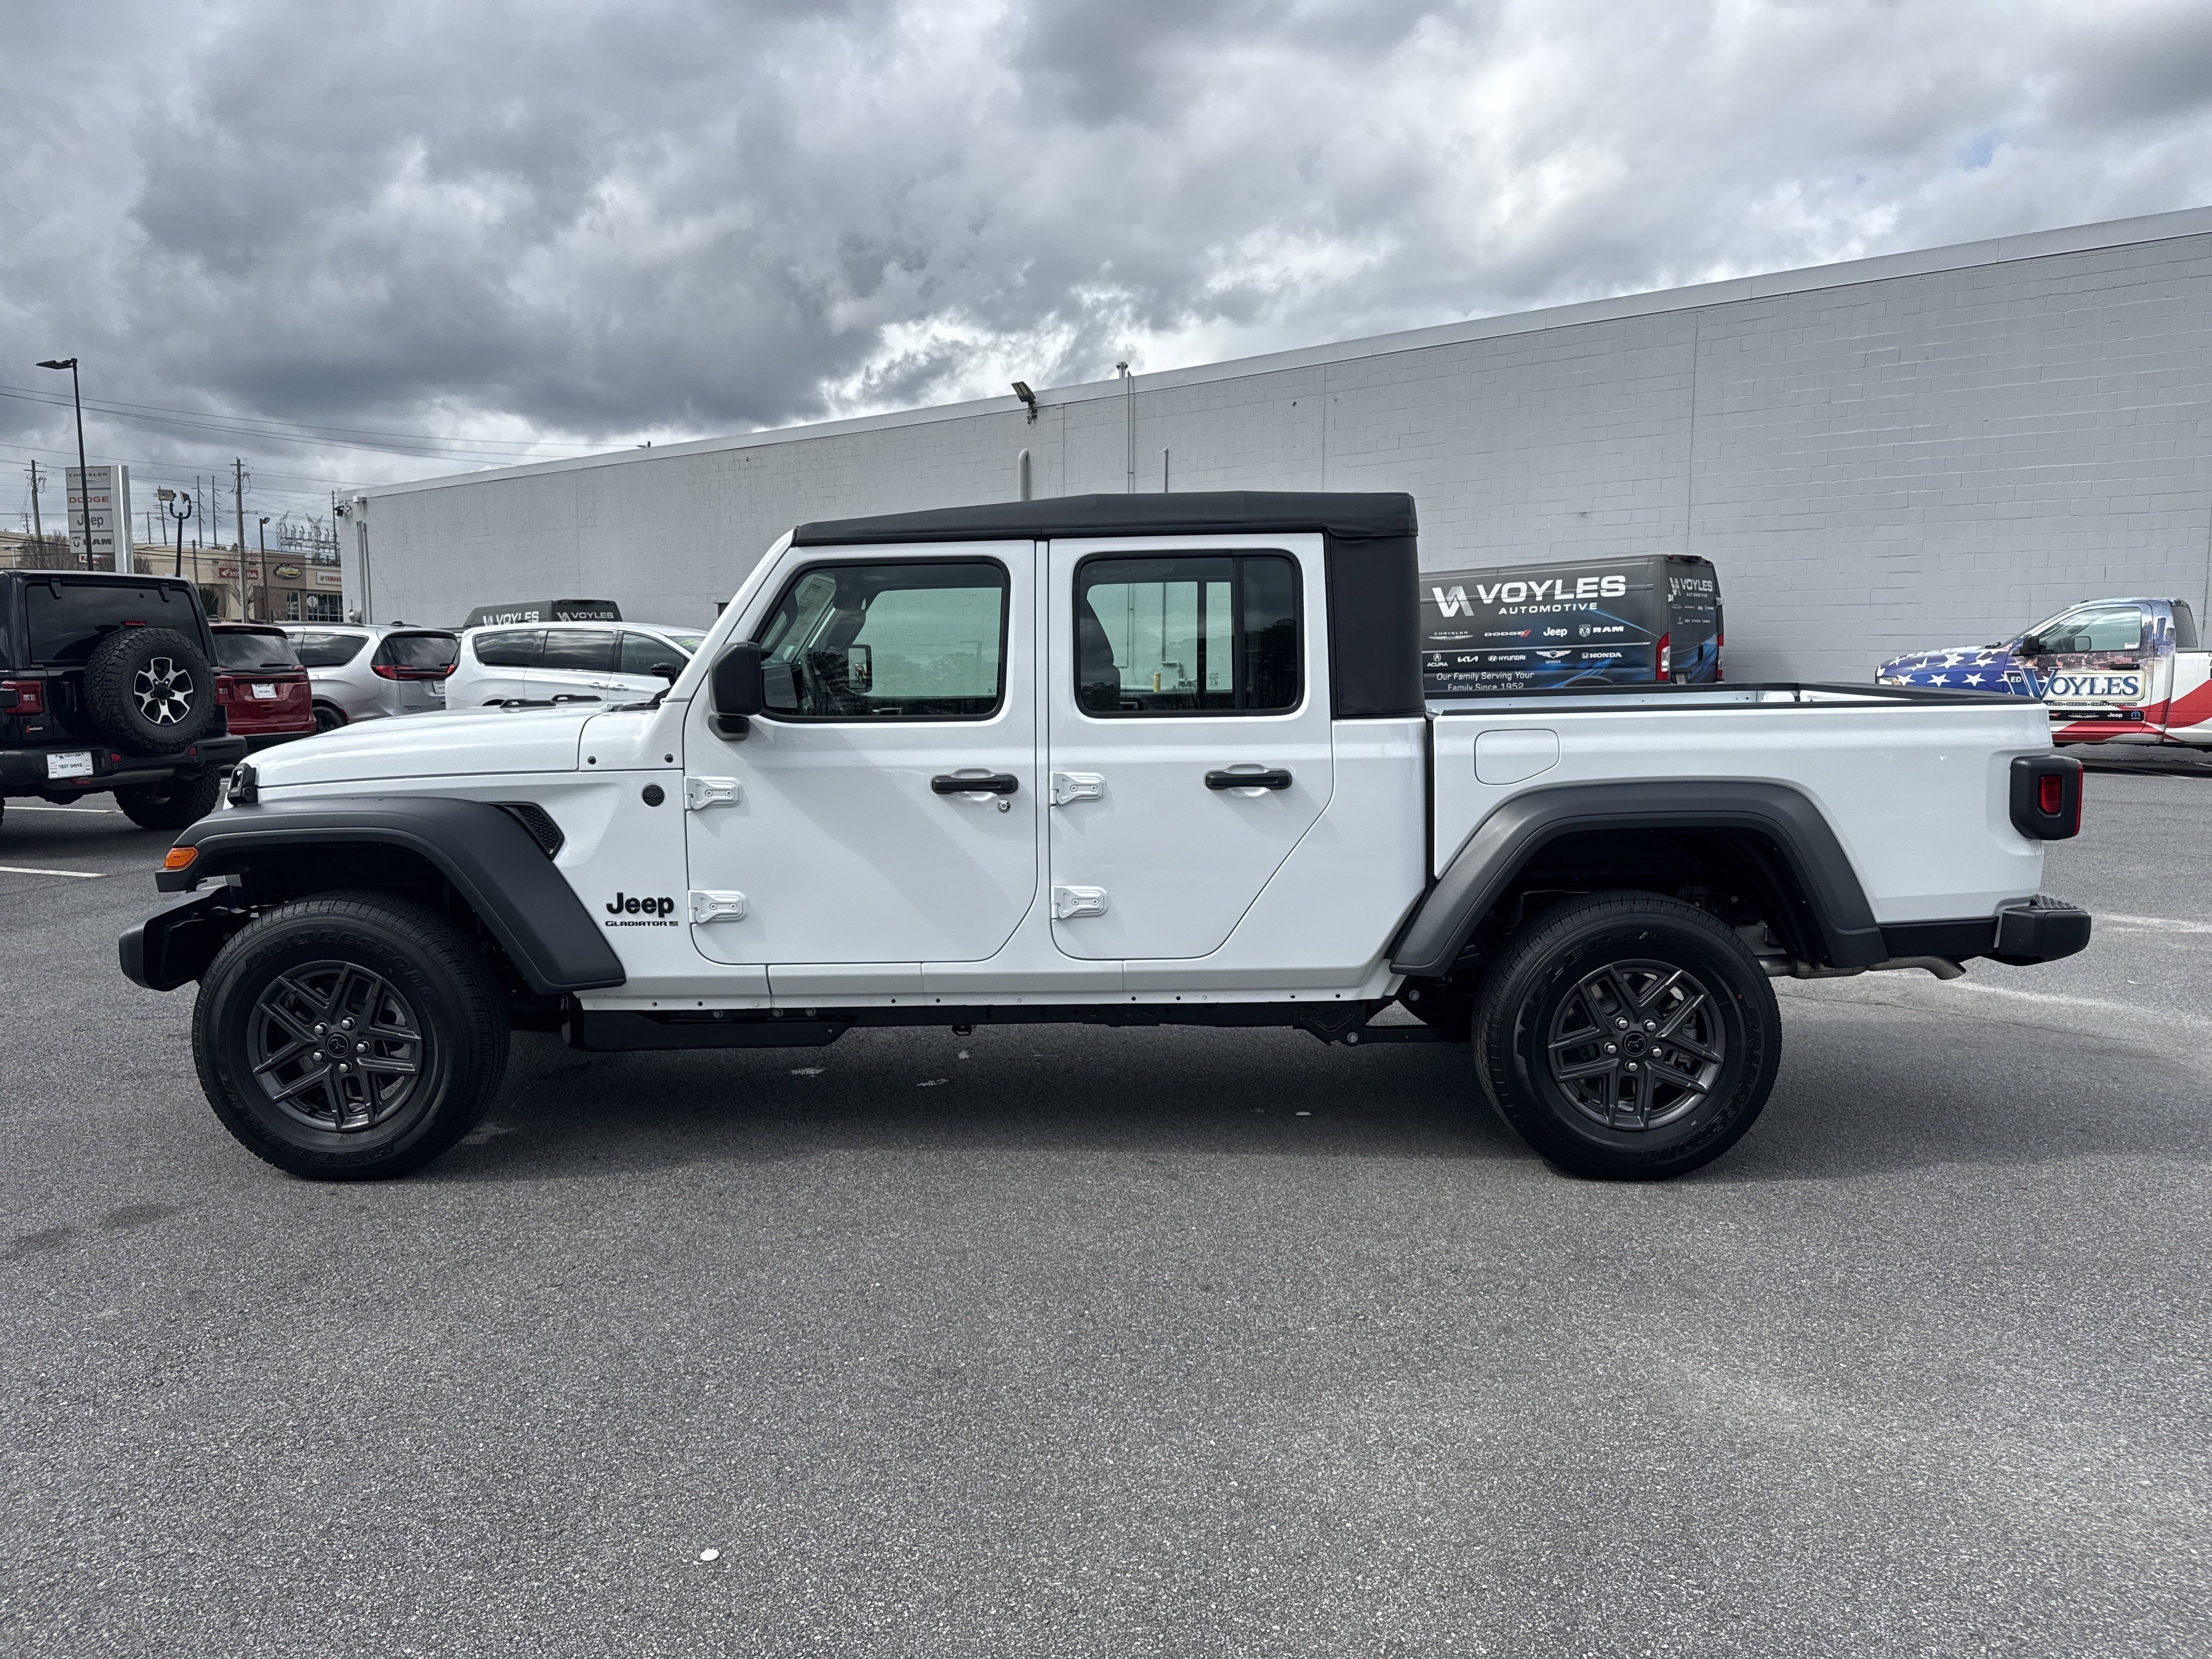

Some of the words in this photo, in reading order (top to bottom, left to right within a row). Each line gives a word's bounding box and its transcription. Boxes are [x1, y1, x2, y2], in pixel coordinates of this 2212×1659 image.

[77, 514, 104, 527] Jep
[1476, 575, 1626, 604] VOYLES
[1680, 578, 1713, 591] VOYLES
[1498, 602, 1598, 615] AUTOMOTIVE
[496, 611, 539, 625] VOYLES
[1543, 627, 1568, 637] Jeep
[1453, 672, 1479, 681] Family
[1481, 672, 1513, 681] Serving
[1515, 671, 1534, 679] Your
[2022, 667, 2139, 702] VOYLES
[606, 891, 674, 918] Jeep
[245, 929, 439, 1003] BRIDGESTONE
